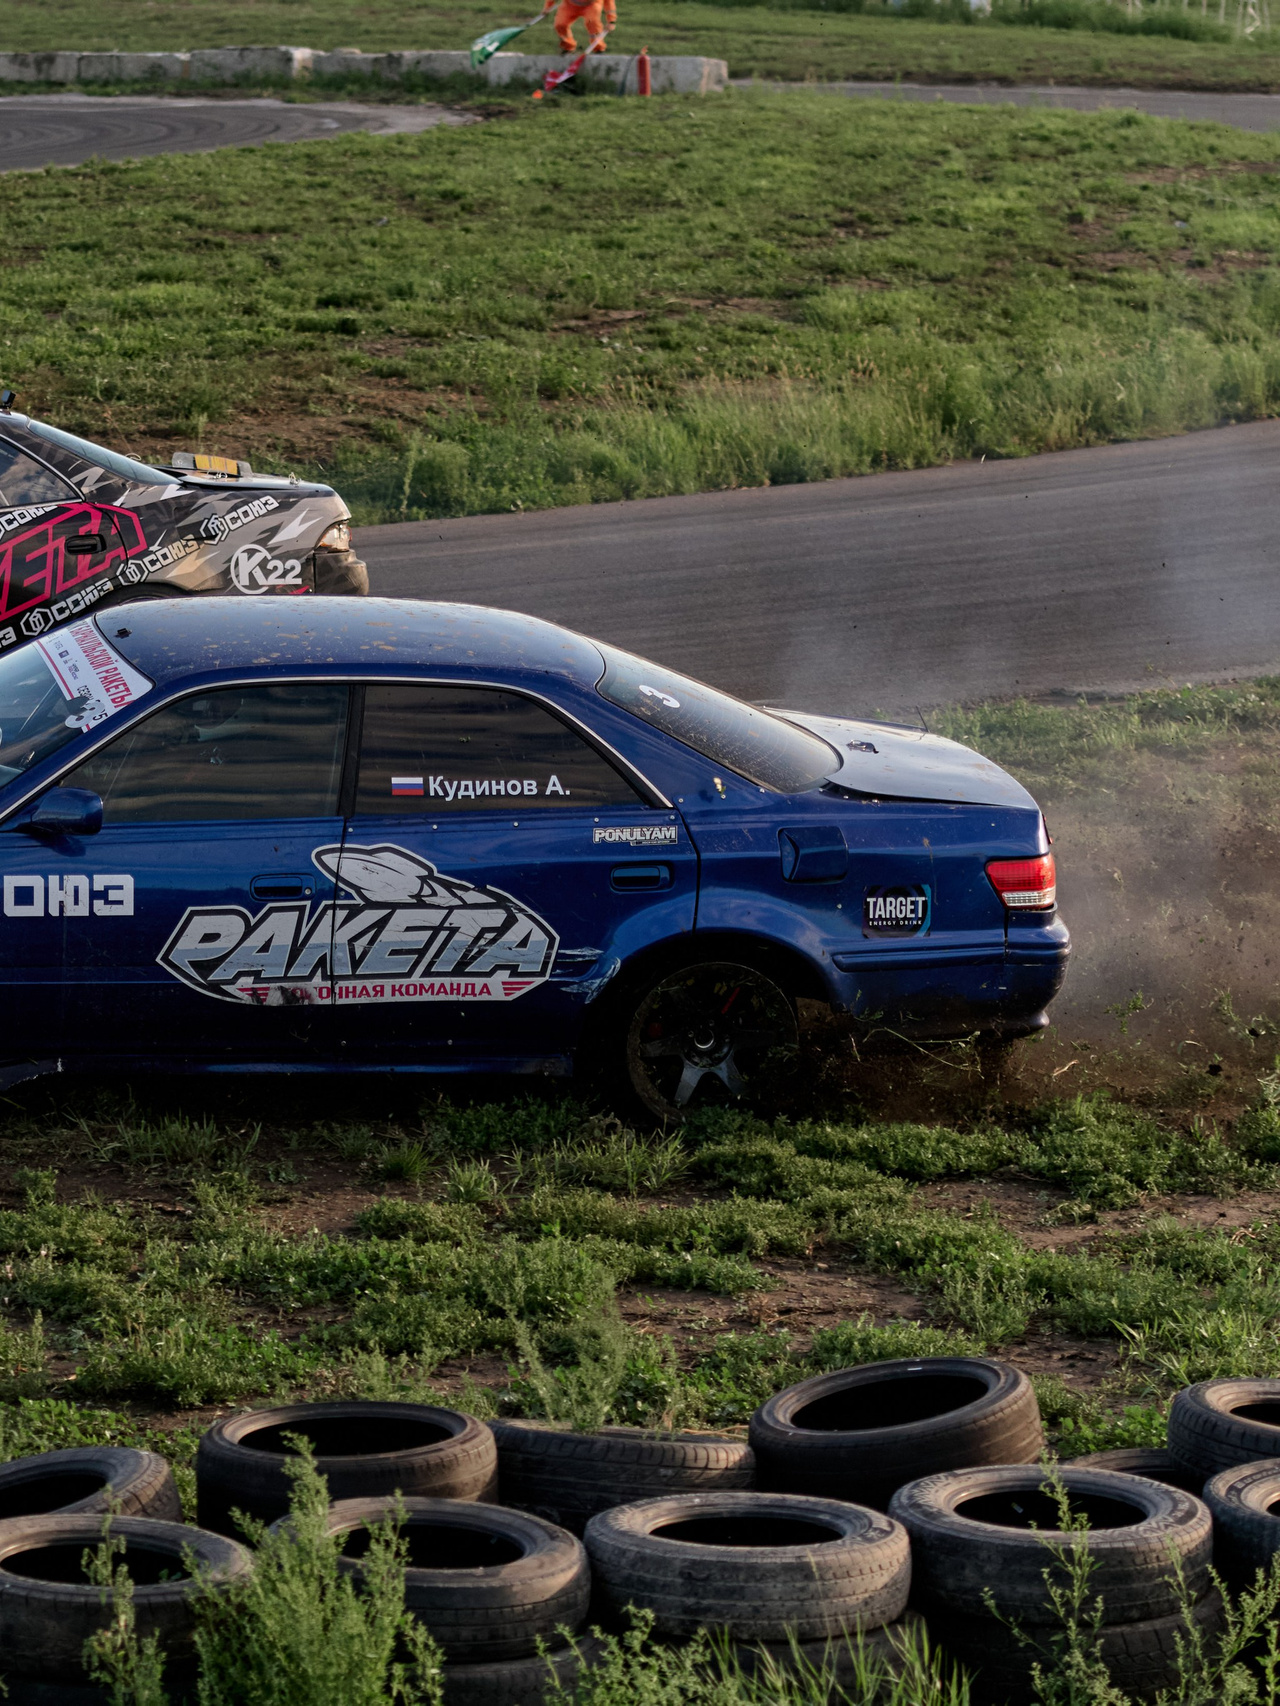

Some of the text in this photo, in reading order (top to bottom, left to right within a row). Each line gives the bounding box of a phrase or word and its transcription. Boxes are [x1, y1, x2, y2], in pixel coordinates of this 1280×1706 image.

[226, 495, 280, 531] СОЮЗ
[143, 533, 201, 573] СОЮЗ
[51, 577, 115, 622] СОЮЗ
[96, 666, 136, 709] РАКЕТЫ
[428, 775, 571, 801] Кудинов А.
[594, 826, 676, 842] PONULYAM
[866, 897, 926, 919] TARGET
[166, 905, 553, 982] РАКЕТА
[391, 981, 492, 998] КОМАНДА
